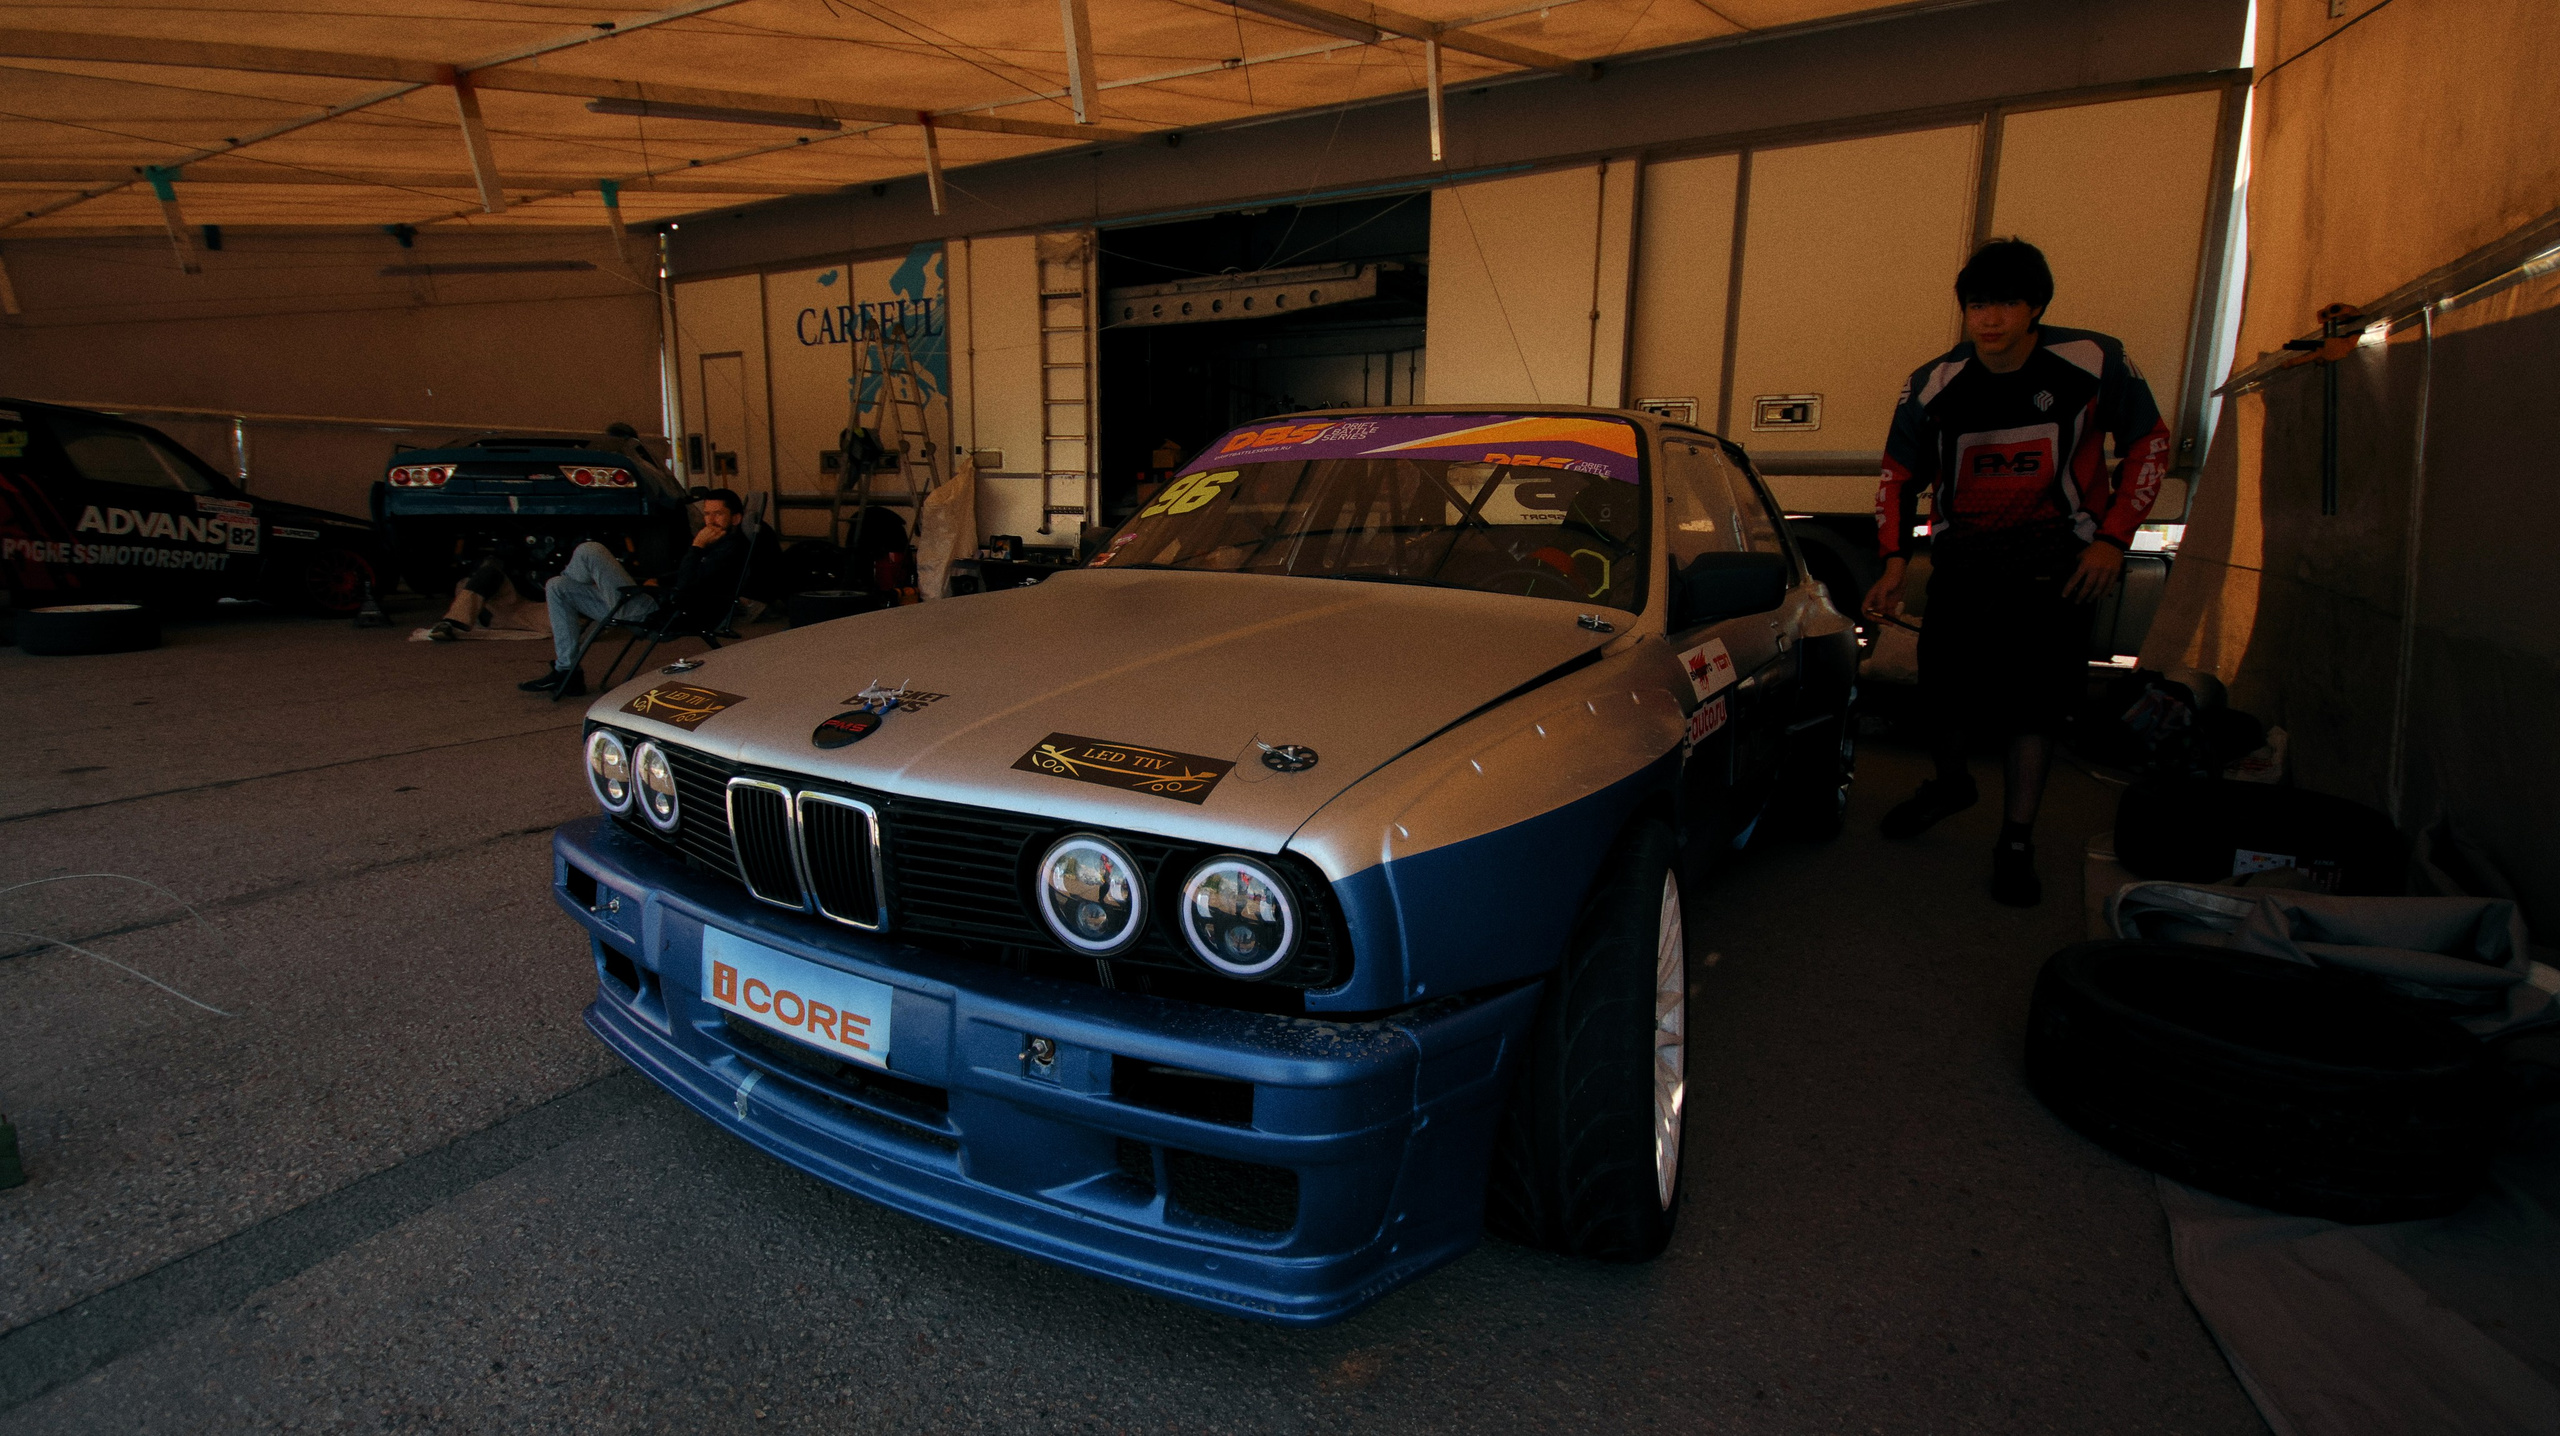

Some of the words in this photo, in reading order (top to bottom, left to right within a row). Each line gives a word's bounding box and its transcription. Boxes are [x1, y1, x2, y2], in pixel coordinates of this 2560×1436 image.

[797, 298, 943, 346] CAREFUL
[1331, 427, 1380, 435] BATTLE
[1342, 422, 1378, 430] DRIFT
[1220, 422, 1337, 454] DBS
[1321, 433, 1367, 441] SERIES
[1580, 461, 1610, 471] DRIFT
[1140, 470, 1240, 519] 96
[231, 527, 255, 546] 82
[665, 690, 691, 701] LED
[821, 719, 868, 732] PMS
[1691, 700, 1726, 741] auto.ru
[1081, 748, 1126, 763] LED
[1133, 755, 1174, 771] TIV
